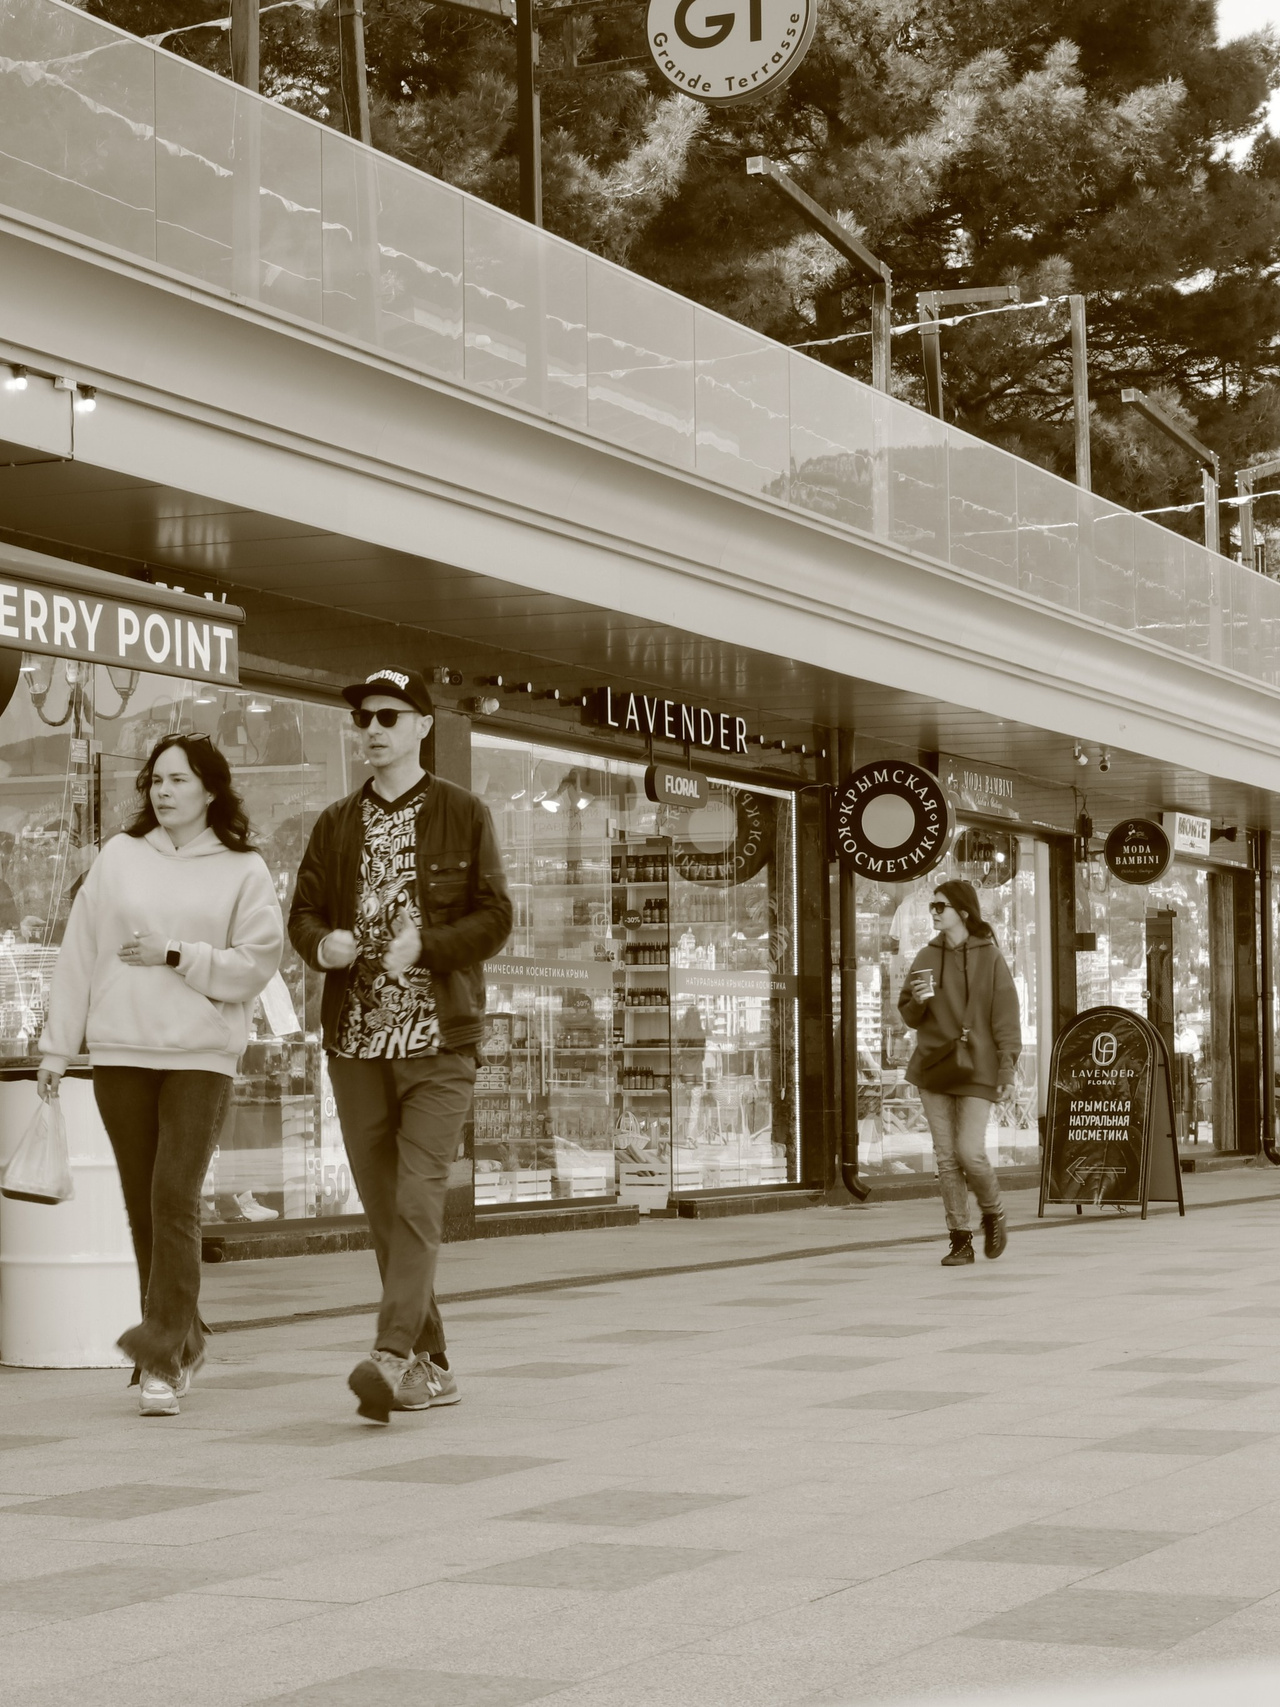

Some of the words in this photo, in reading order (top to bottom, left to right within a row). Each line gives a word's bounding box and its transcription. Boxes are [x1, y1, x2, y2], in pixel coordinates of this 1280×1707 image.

[653, 32, 712, 92] Grande
[725, 12, 800, 92] Terrasse
[117, 606, 234, 675] POINT
[606, 685, 749, 754] LAVENDER
[665, 774, 700, 799] FLORAL
[839, 768, 938, 816] КРЫМСКАЯ
[962, 770, 982, 792] MODA
[984, 775, 1013, 798] BAMBINI
[1177, 816, 1207, 840] MONTE
[837, 823, 940, 873] КОСМЕТИКА
[1122, 845, 1151, 854] MODA
[1115, 855, 1160, 865] BAMBINI
[624, 916, 641, 924] -30%
[483, 963, 524, 975] АНИЧЕСКАЯ
[526, 966, 565, 978] КОСМЕТИКА
[566, 969, 589, 979] КРЫМА
[685, 977, 725, 987] НАТУРАЛЬНАЯ
[726, 979, 754, 989] КРЫМСКАЯ
[755, 981, 787, 990] КОСМЕТИКА
[1071, 1069, 1135, 1078] LAVENDER
[1070, 1100, 1131, 1112] КРЫМСКАЯ
[1069, 1115, 1130, 1127] НАТУРАЛЬНАЯ
[1068, 1129, 1129, 1141] КОСМЕТИКА
